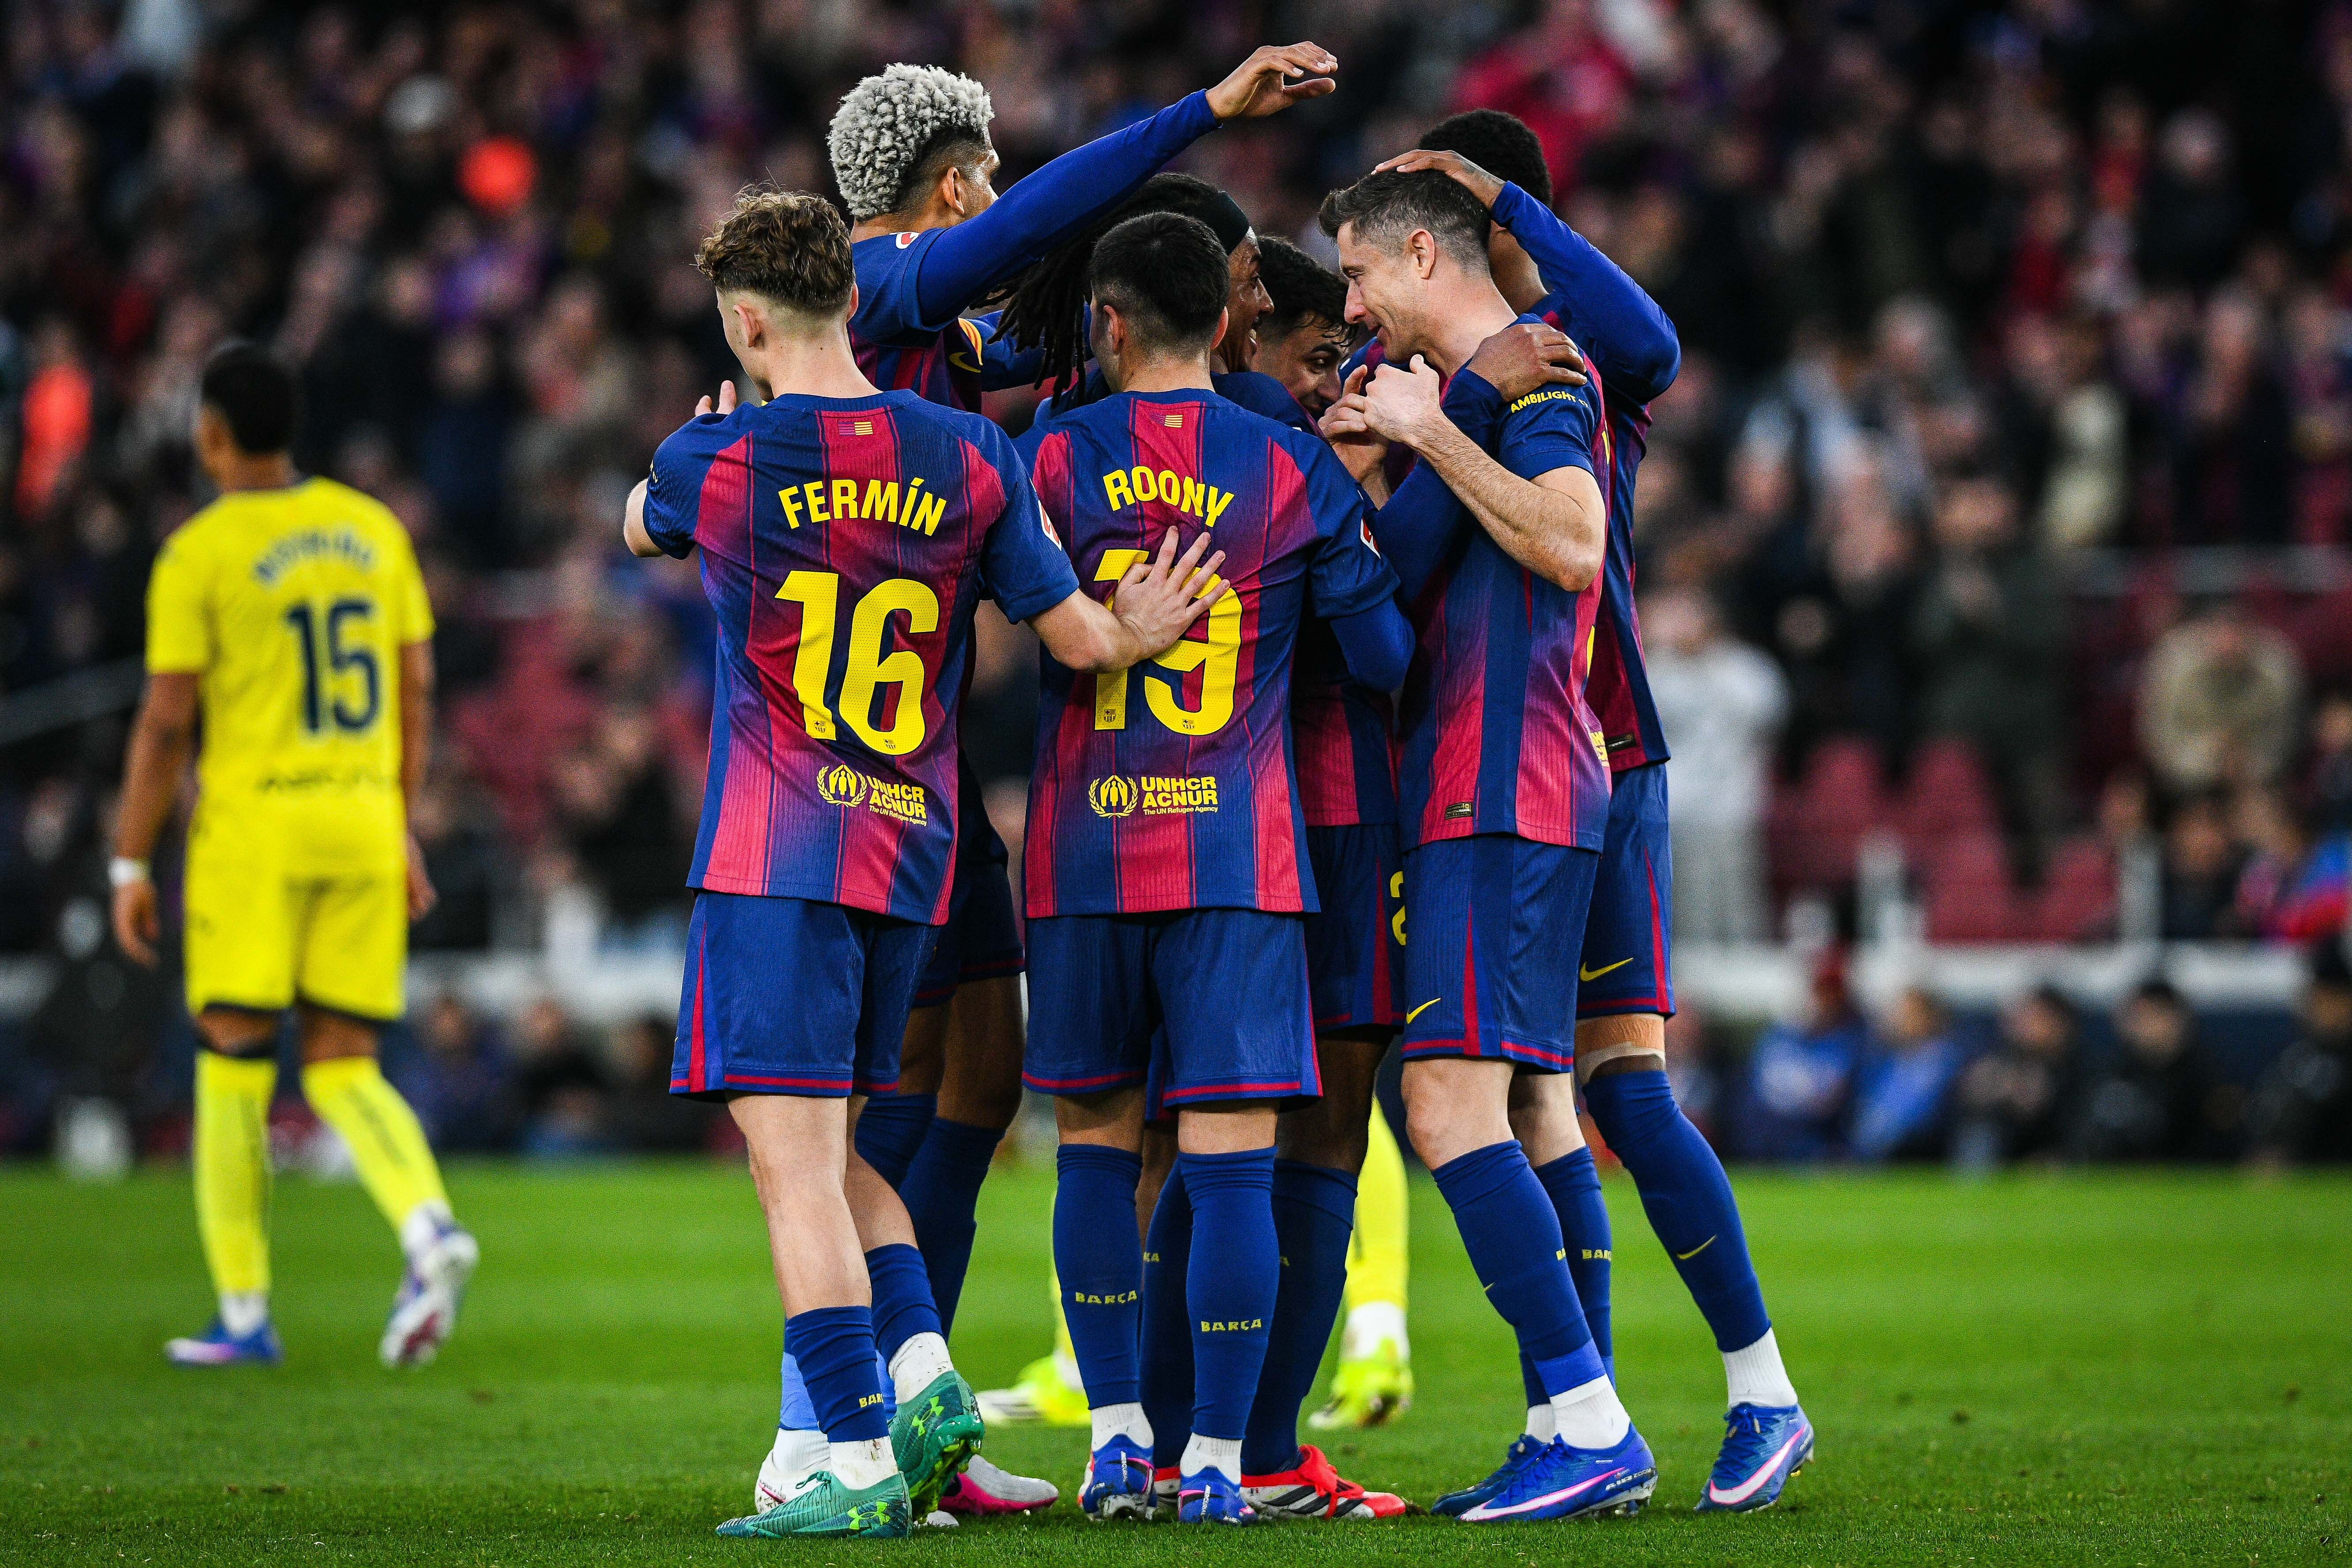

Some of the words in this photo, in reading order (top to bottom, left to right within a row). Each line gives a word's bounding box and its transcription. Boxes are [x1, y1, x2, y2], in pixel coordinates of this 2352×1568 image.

[1510, 391, 1576, 413] AMBILIGHT
[778, 477, 947, 536] FERMÍN
[1102, 465, 1235, 528] ROONY
[1094, 549, 1243, 736] 19
[285, 601, 379, 732] 15
[774, 571, 939, 755] 16
[866, 775, 925, 803] UNHCR
[1141, 776, 1217, 792] UNHCR
[869, 790, 927, 819] ACNUR
[1142, 790, 1218, 808] ACNUR
[889, 810, 909, 821] Refugee
[909, 816, 927, 827] Agency
